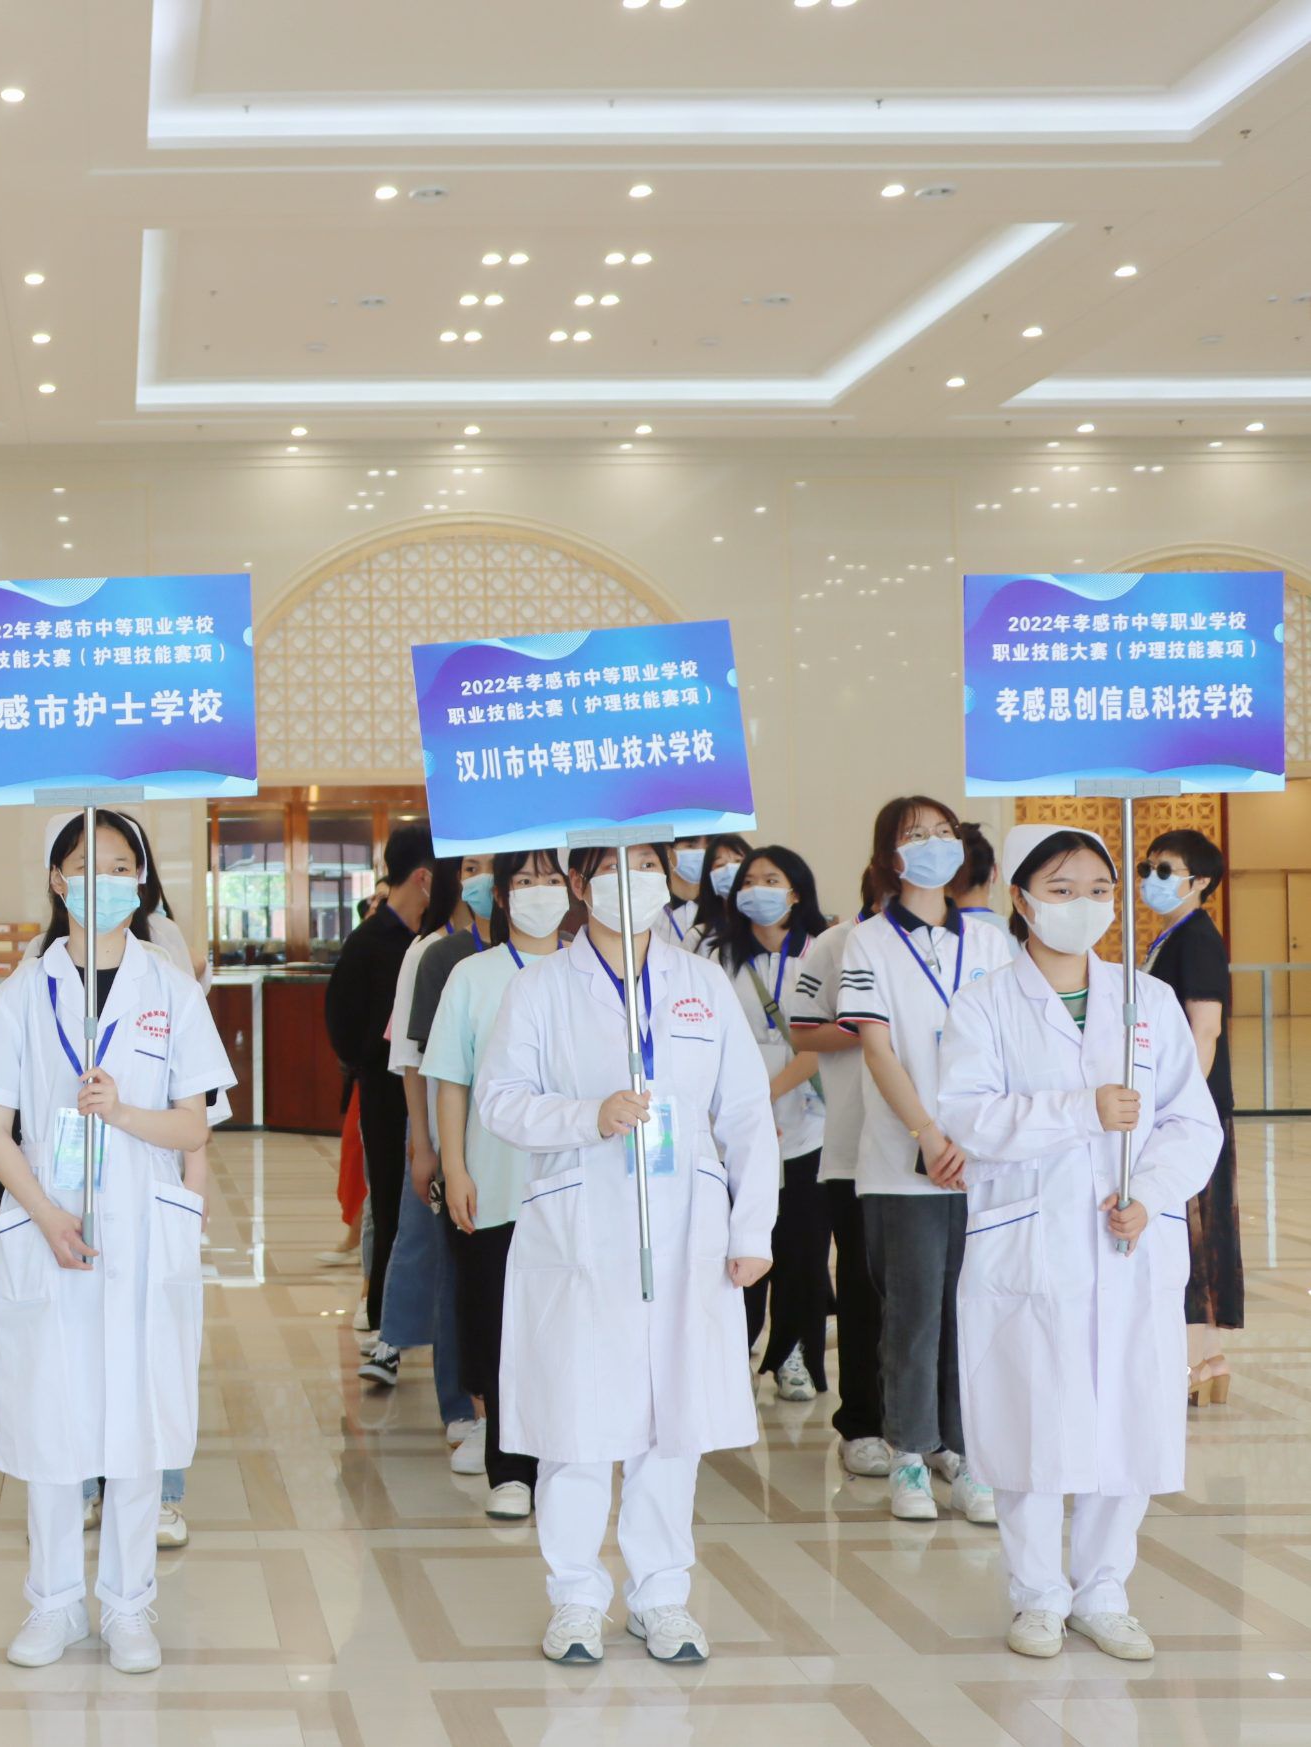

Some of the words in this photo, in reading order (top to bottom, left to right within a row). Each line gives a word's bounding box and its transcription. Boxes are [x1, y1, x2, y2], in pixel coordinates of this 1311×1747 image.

[1008, 612, 1246, 633] 2022年孝感市中等职业学校
[461, 660, 698, 696] 2022年孝感市中等职业学校
[996, 684, 1253, 722] 孝感思创信息科技学校
[456, 728, 716, 782] 汉川市中等职业技术学校
